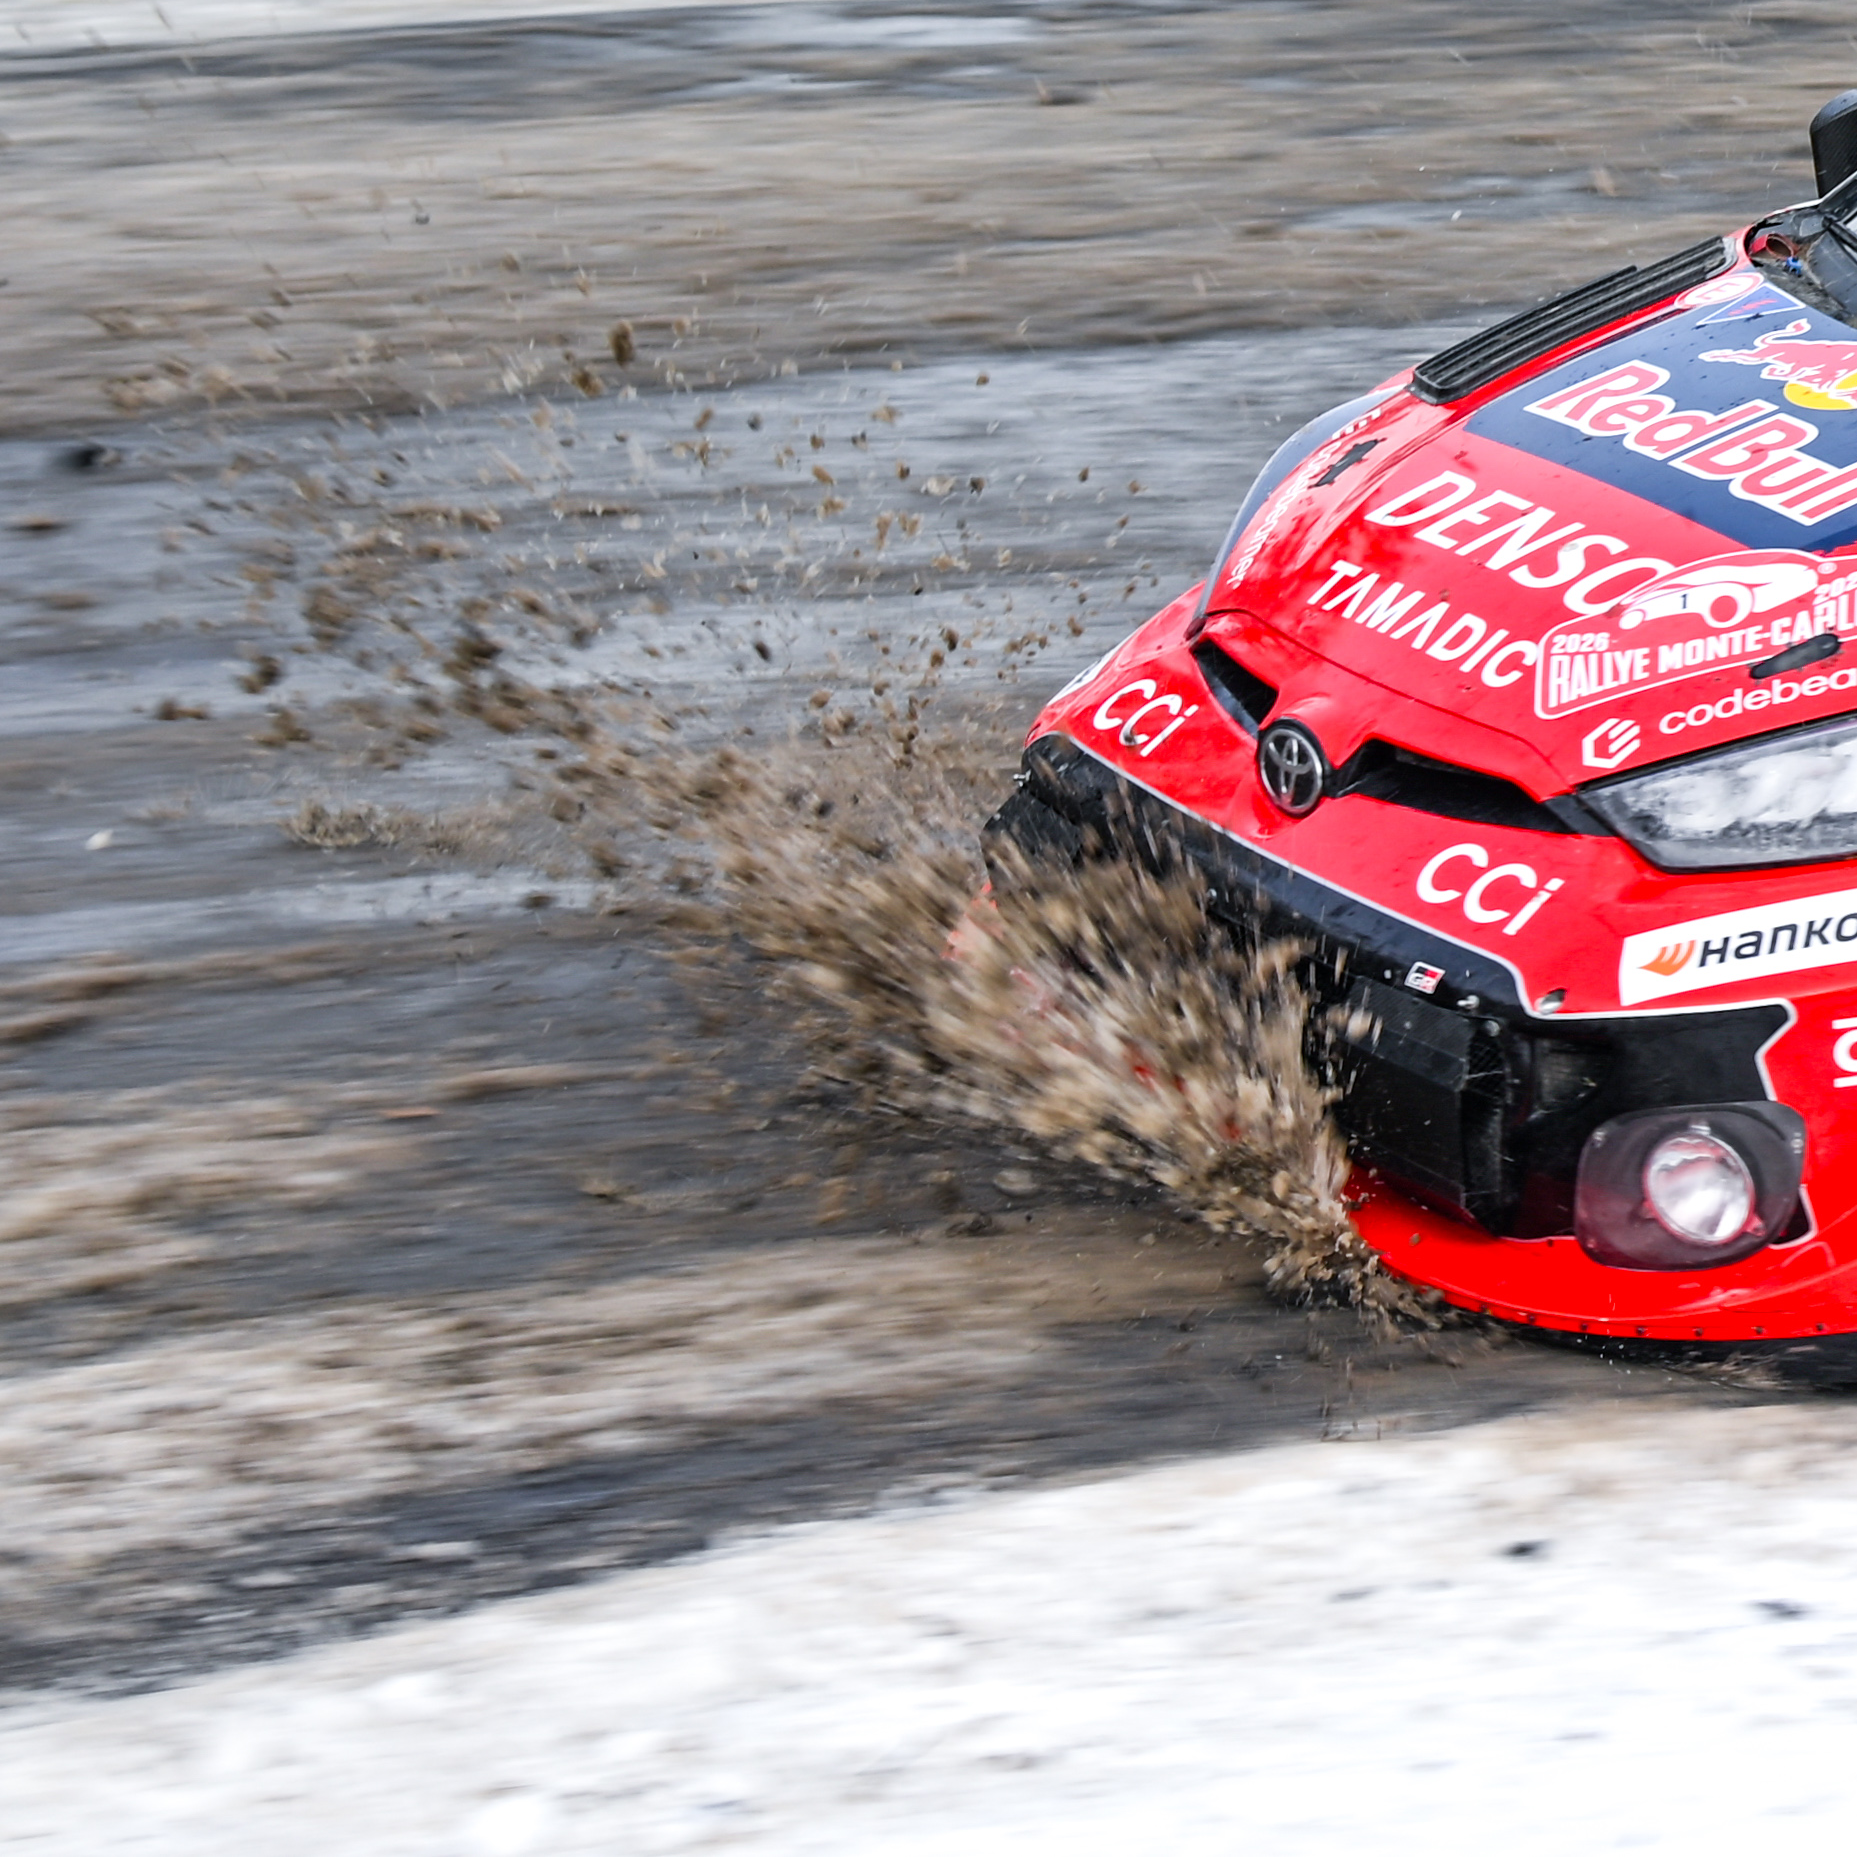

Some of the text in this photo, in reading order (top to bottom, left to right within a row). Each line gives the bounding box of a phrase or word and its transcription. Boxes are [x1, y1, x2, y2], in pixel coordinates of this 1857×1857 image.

[1363, 470, 1678, 615] DENSO
[1306, 559, 1538, 688] TAMADIC
[1679, 593, 1689, 610] 1
[1550, 631, 1612, 654] 2026
[1548, 648, 1650, 708] RALLYE
